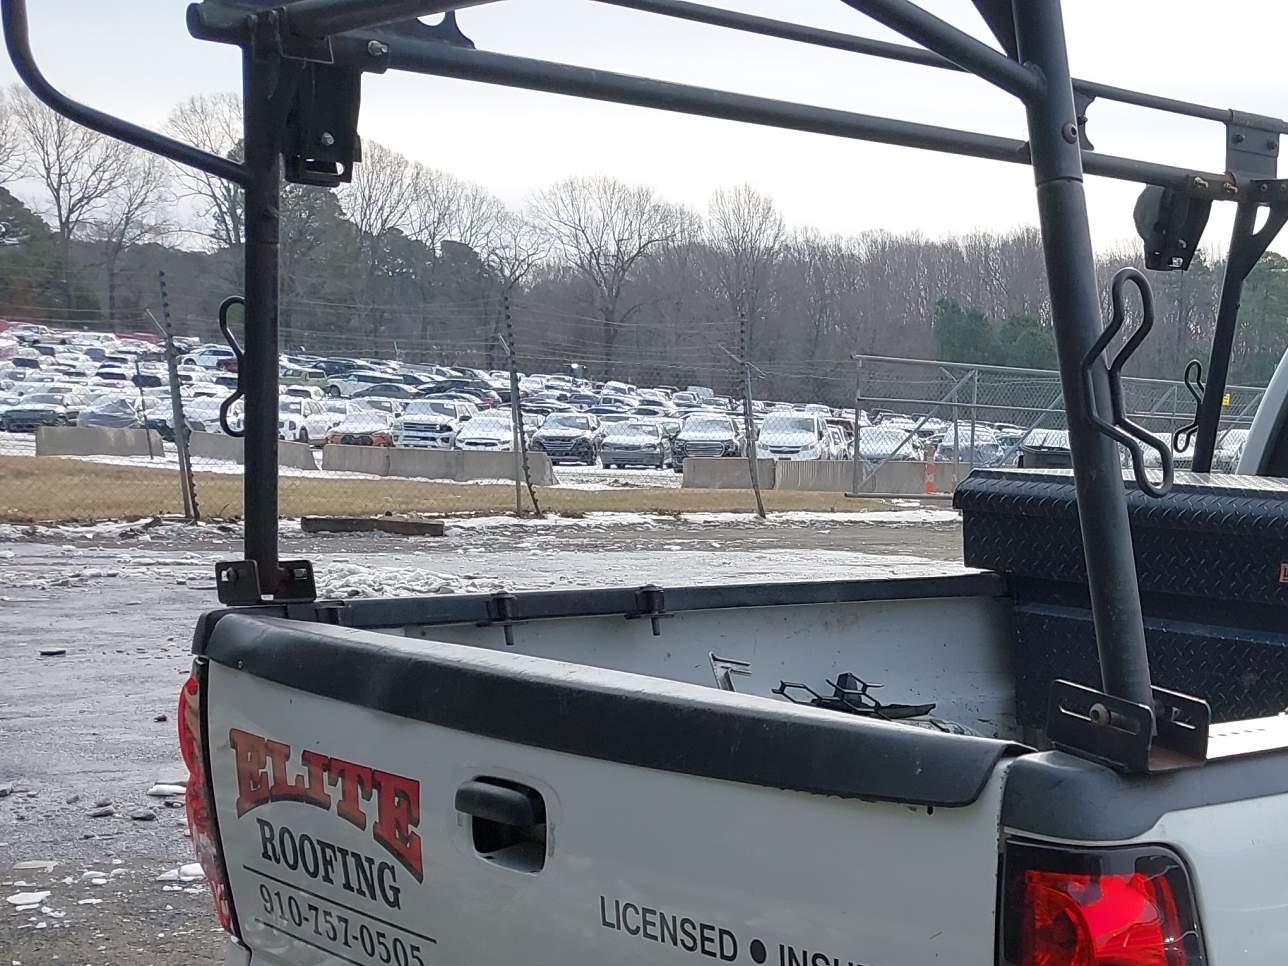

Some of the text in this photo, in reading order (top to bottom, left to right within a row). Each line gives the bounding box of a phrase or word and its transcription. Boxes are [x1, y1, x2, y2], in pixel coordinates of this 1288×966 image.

[229, 728, 424, 884] ELITE
[256, 816, 401, 910] ROOFING
[599, 895, 739, 962] LICENSED
